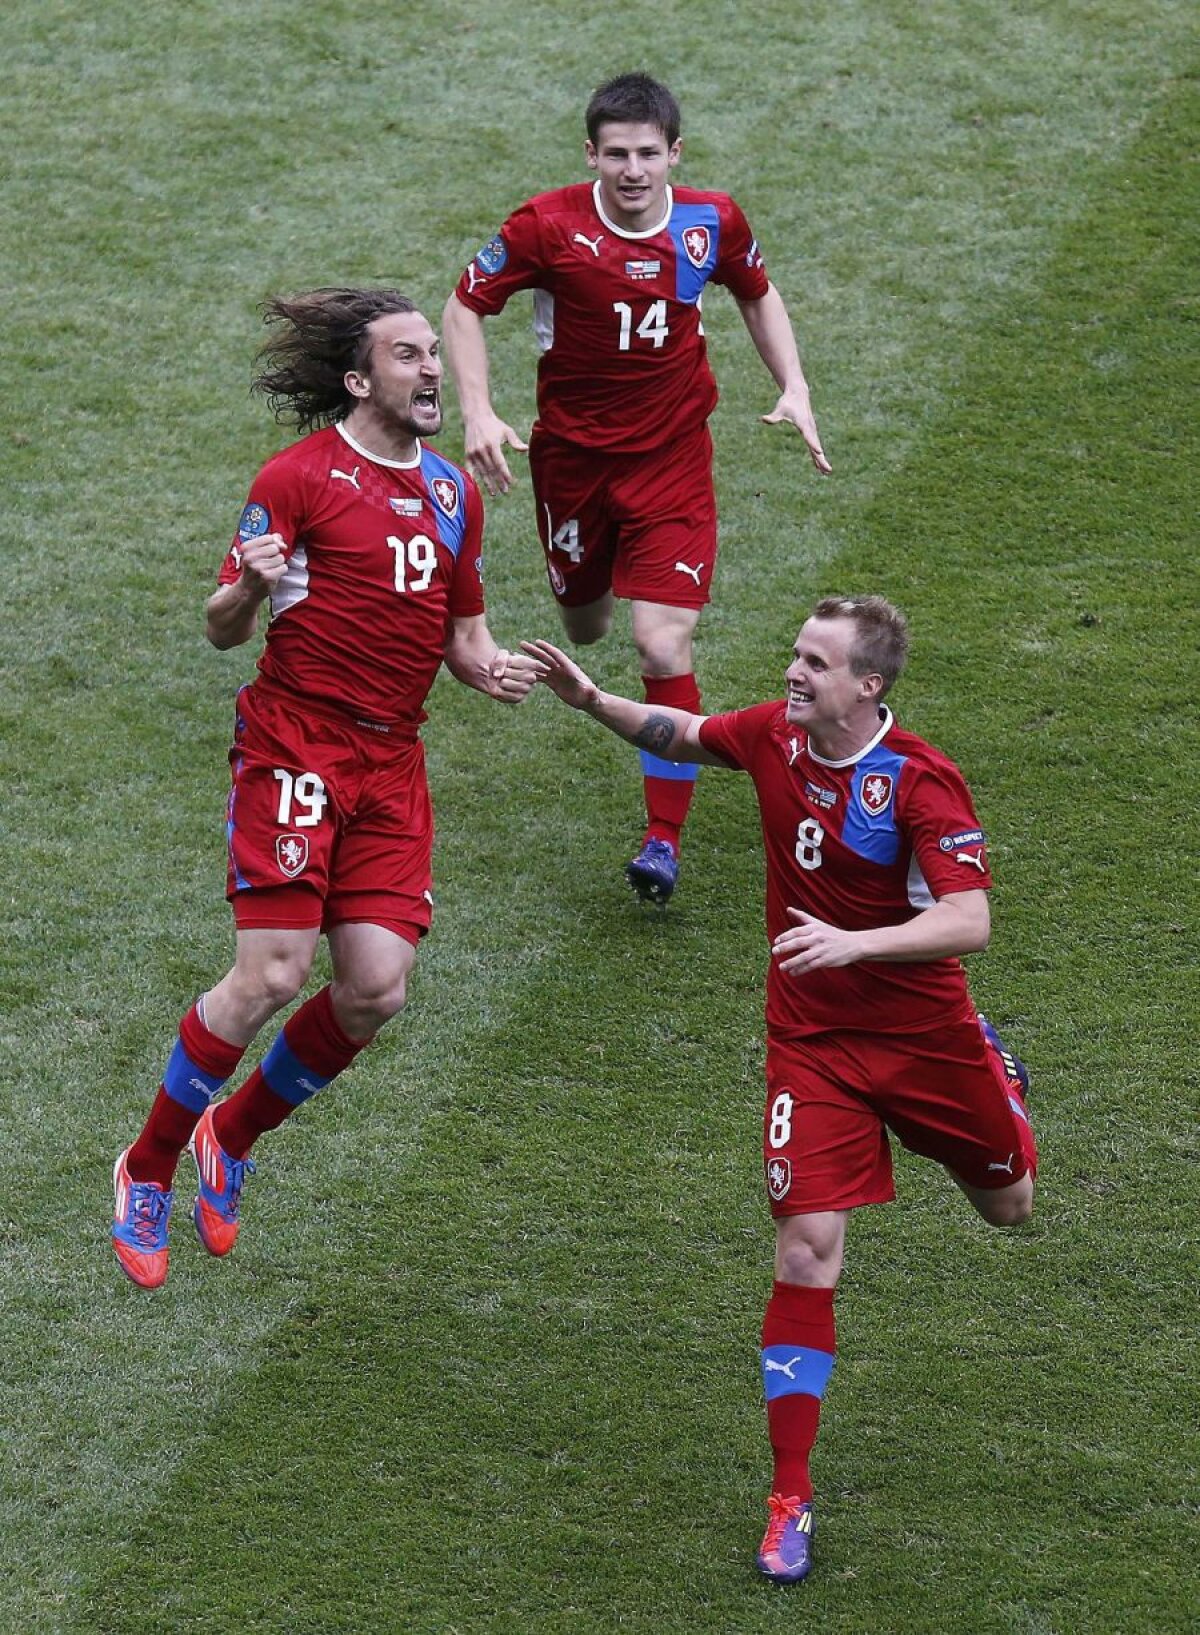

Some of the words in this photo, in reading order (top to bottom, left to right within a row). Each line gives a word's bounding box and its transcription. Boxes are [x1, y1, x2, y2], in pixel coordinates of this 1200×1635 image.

[613, 299, 669, 350] 14
[386, 534, 438, 593] 19
[272, 768, 328, 828] 19
[795, 817, 825, 871] 8
[768, 1092, 794, 1149] 8
